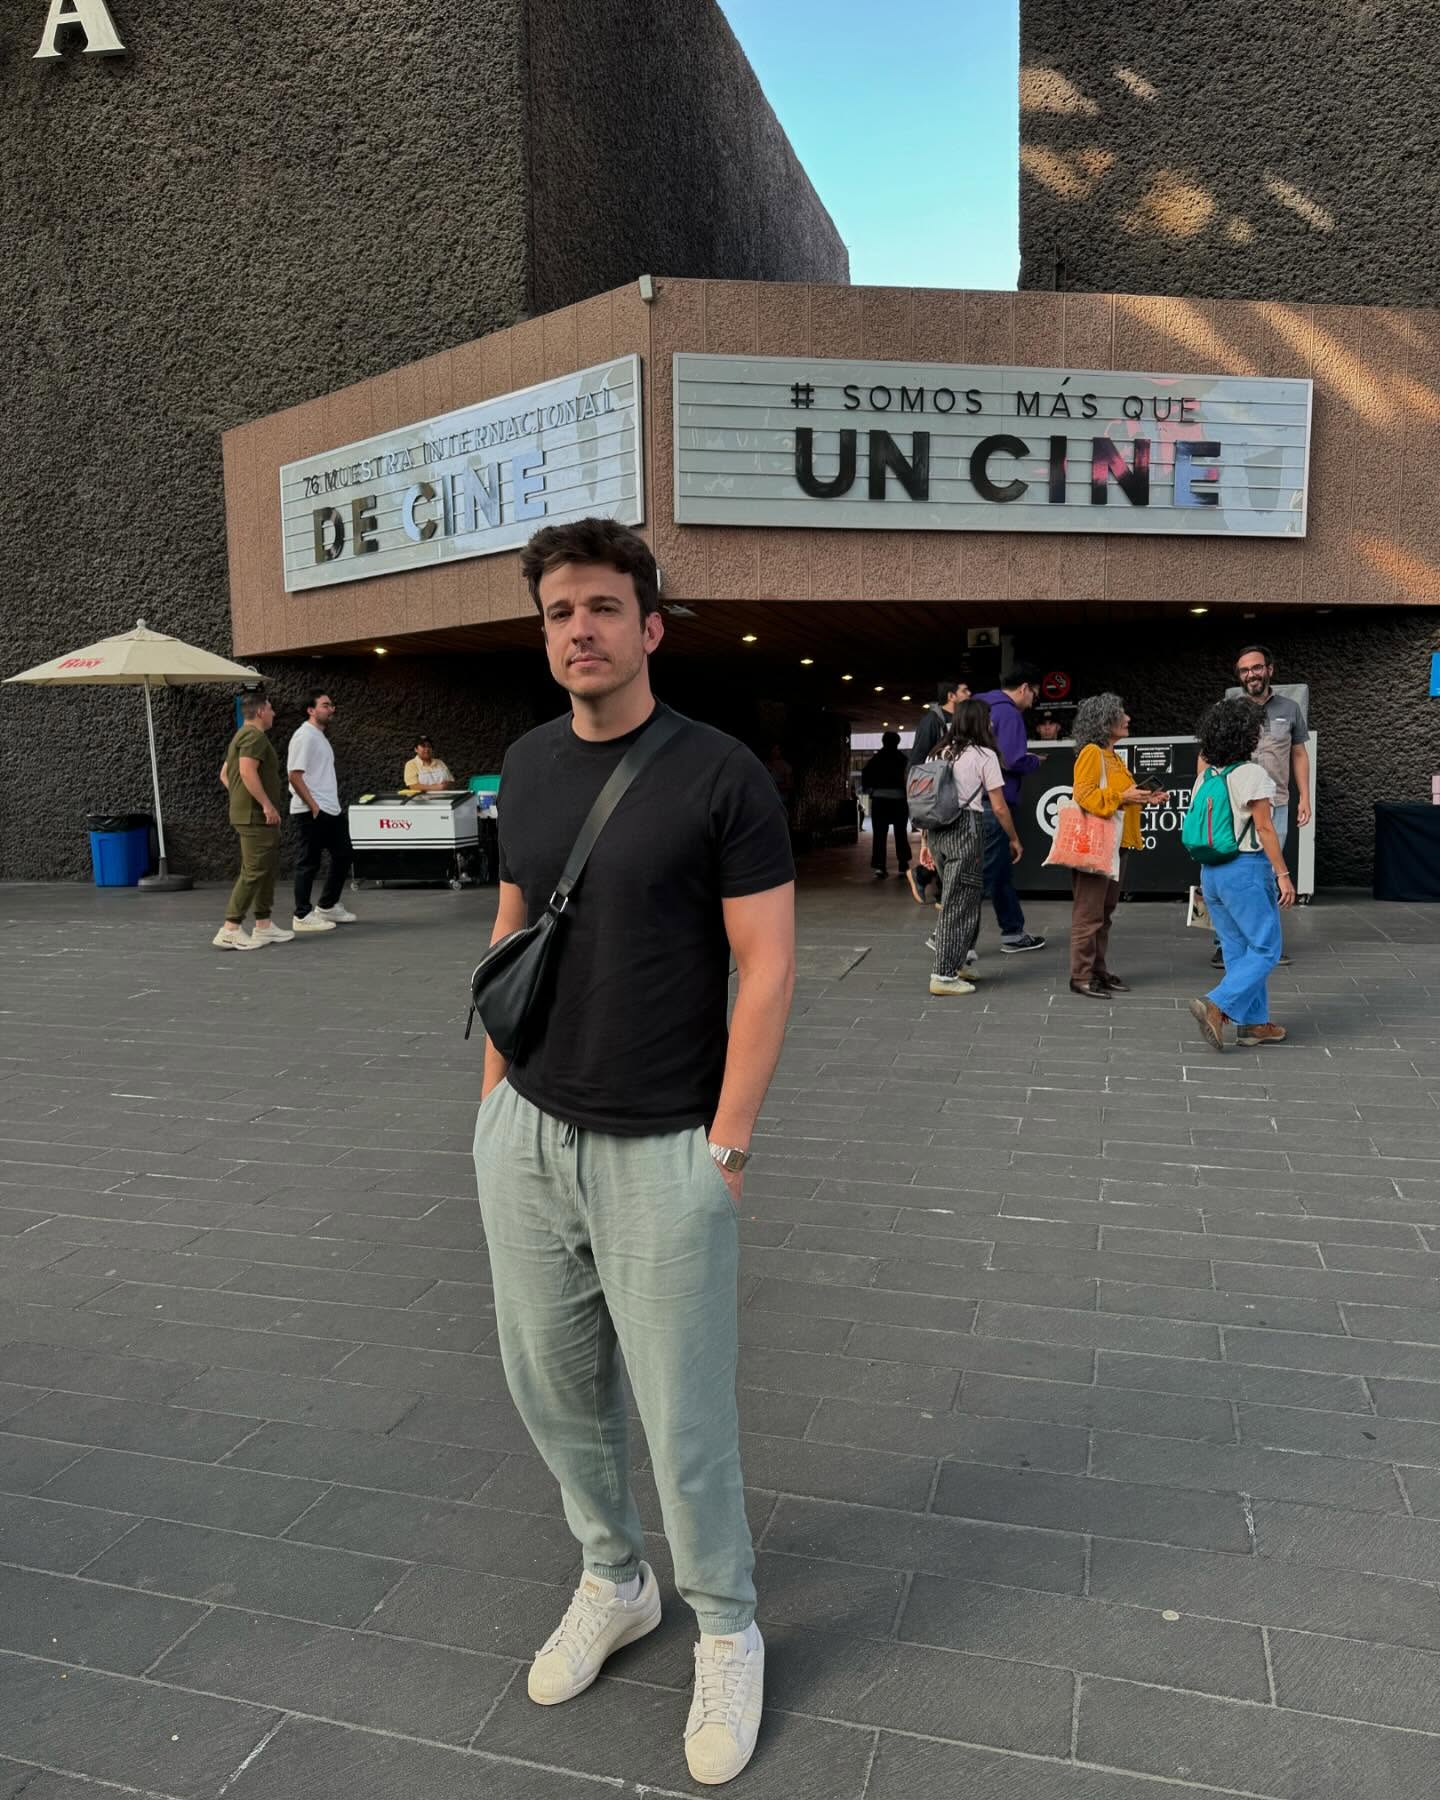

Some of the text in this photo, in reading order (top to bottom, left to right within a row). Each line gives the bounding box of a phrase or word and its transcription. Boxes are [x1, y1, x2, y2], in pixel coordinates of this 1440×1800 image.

[32, 0, 126, 59] A
[791, 376, 1198, 424] # SOMOS MÁS QUE
[303, 387, 615, 498] 76 MUESTRA INTERNACIONAL
[795, 427, 1222, 508] UN CINE
[313, 449, 548, 564] DE CINE
[379, 818, 413, 831] Roxy
